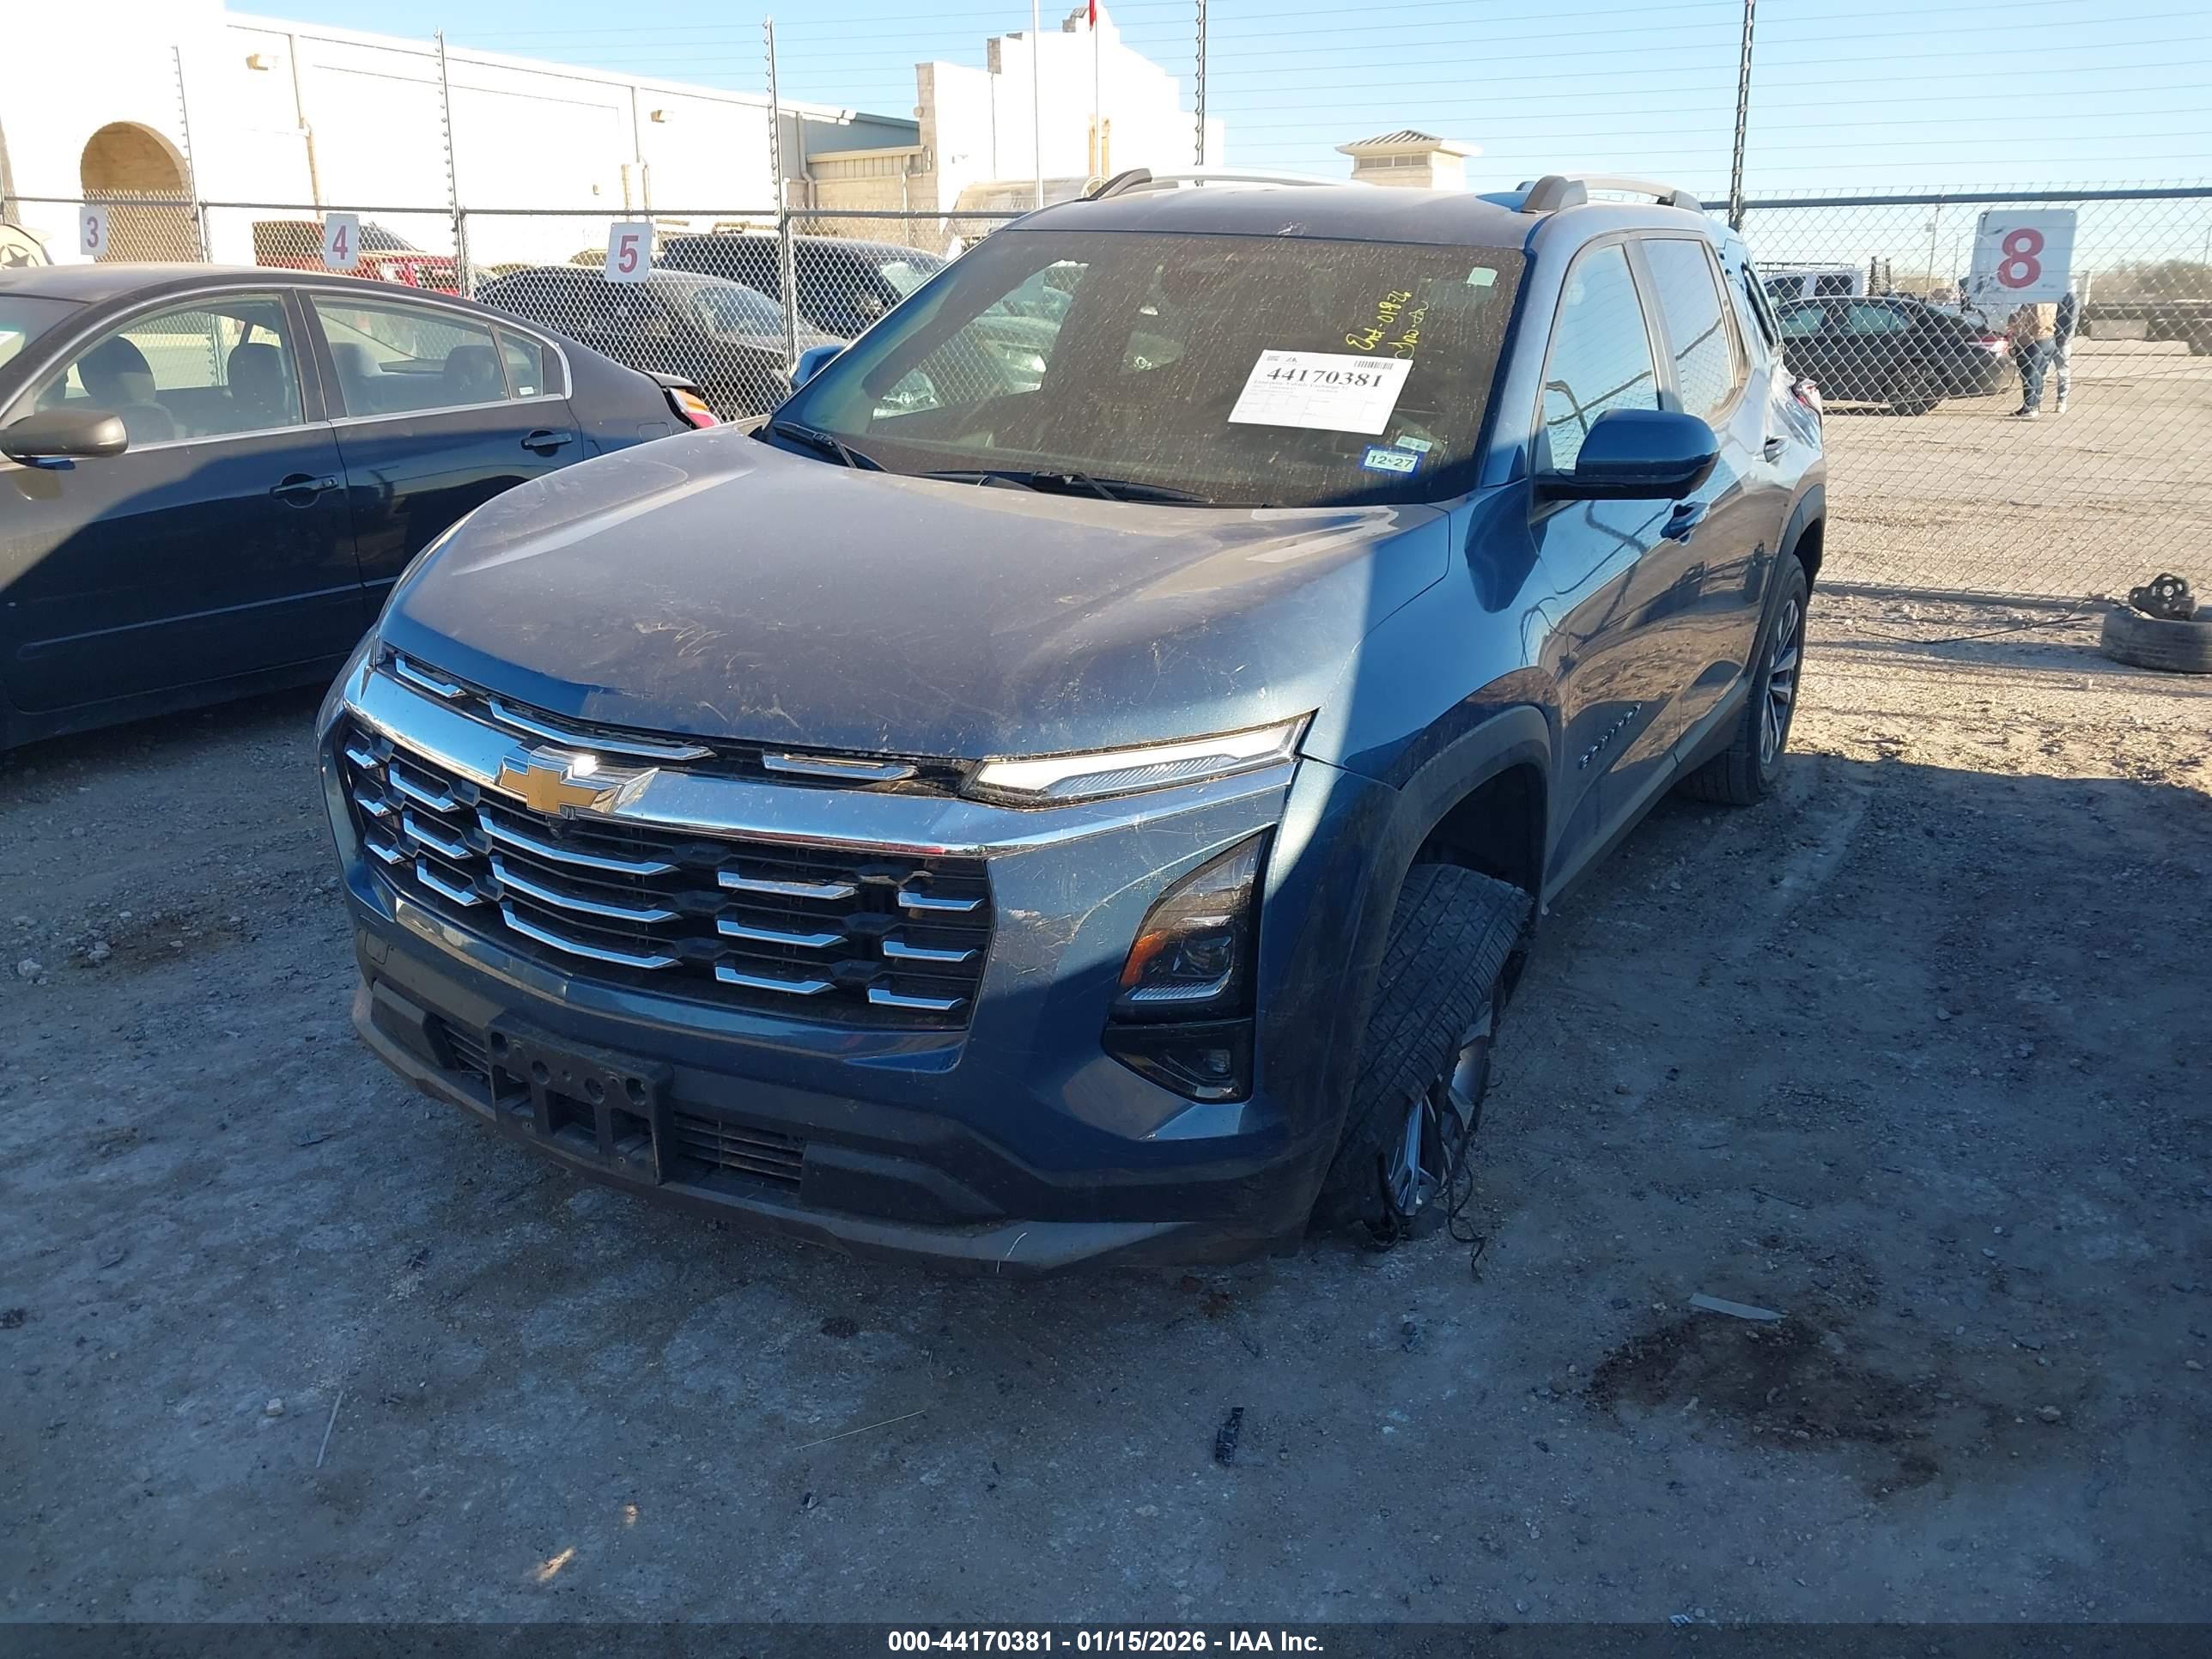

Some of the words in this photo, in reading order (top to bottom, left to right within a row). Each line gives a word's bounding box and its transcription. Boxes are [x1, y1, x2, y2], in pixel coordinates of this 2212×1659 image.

[87, 216, 99, 248] 3
[332, 225, 348, 260] 4
[618, 235, 639, 273] 5
[1997, 228, 2045, 289] 8
[1267, 368, 1382, 387] 44170381
